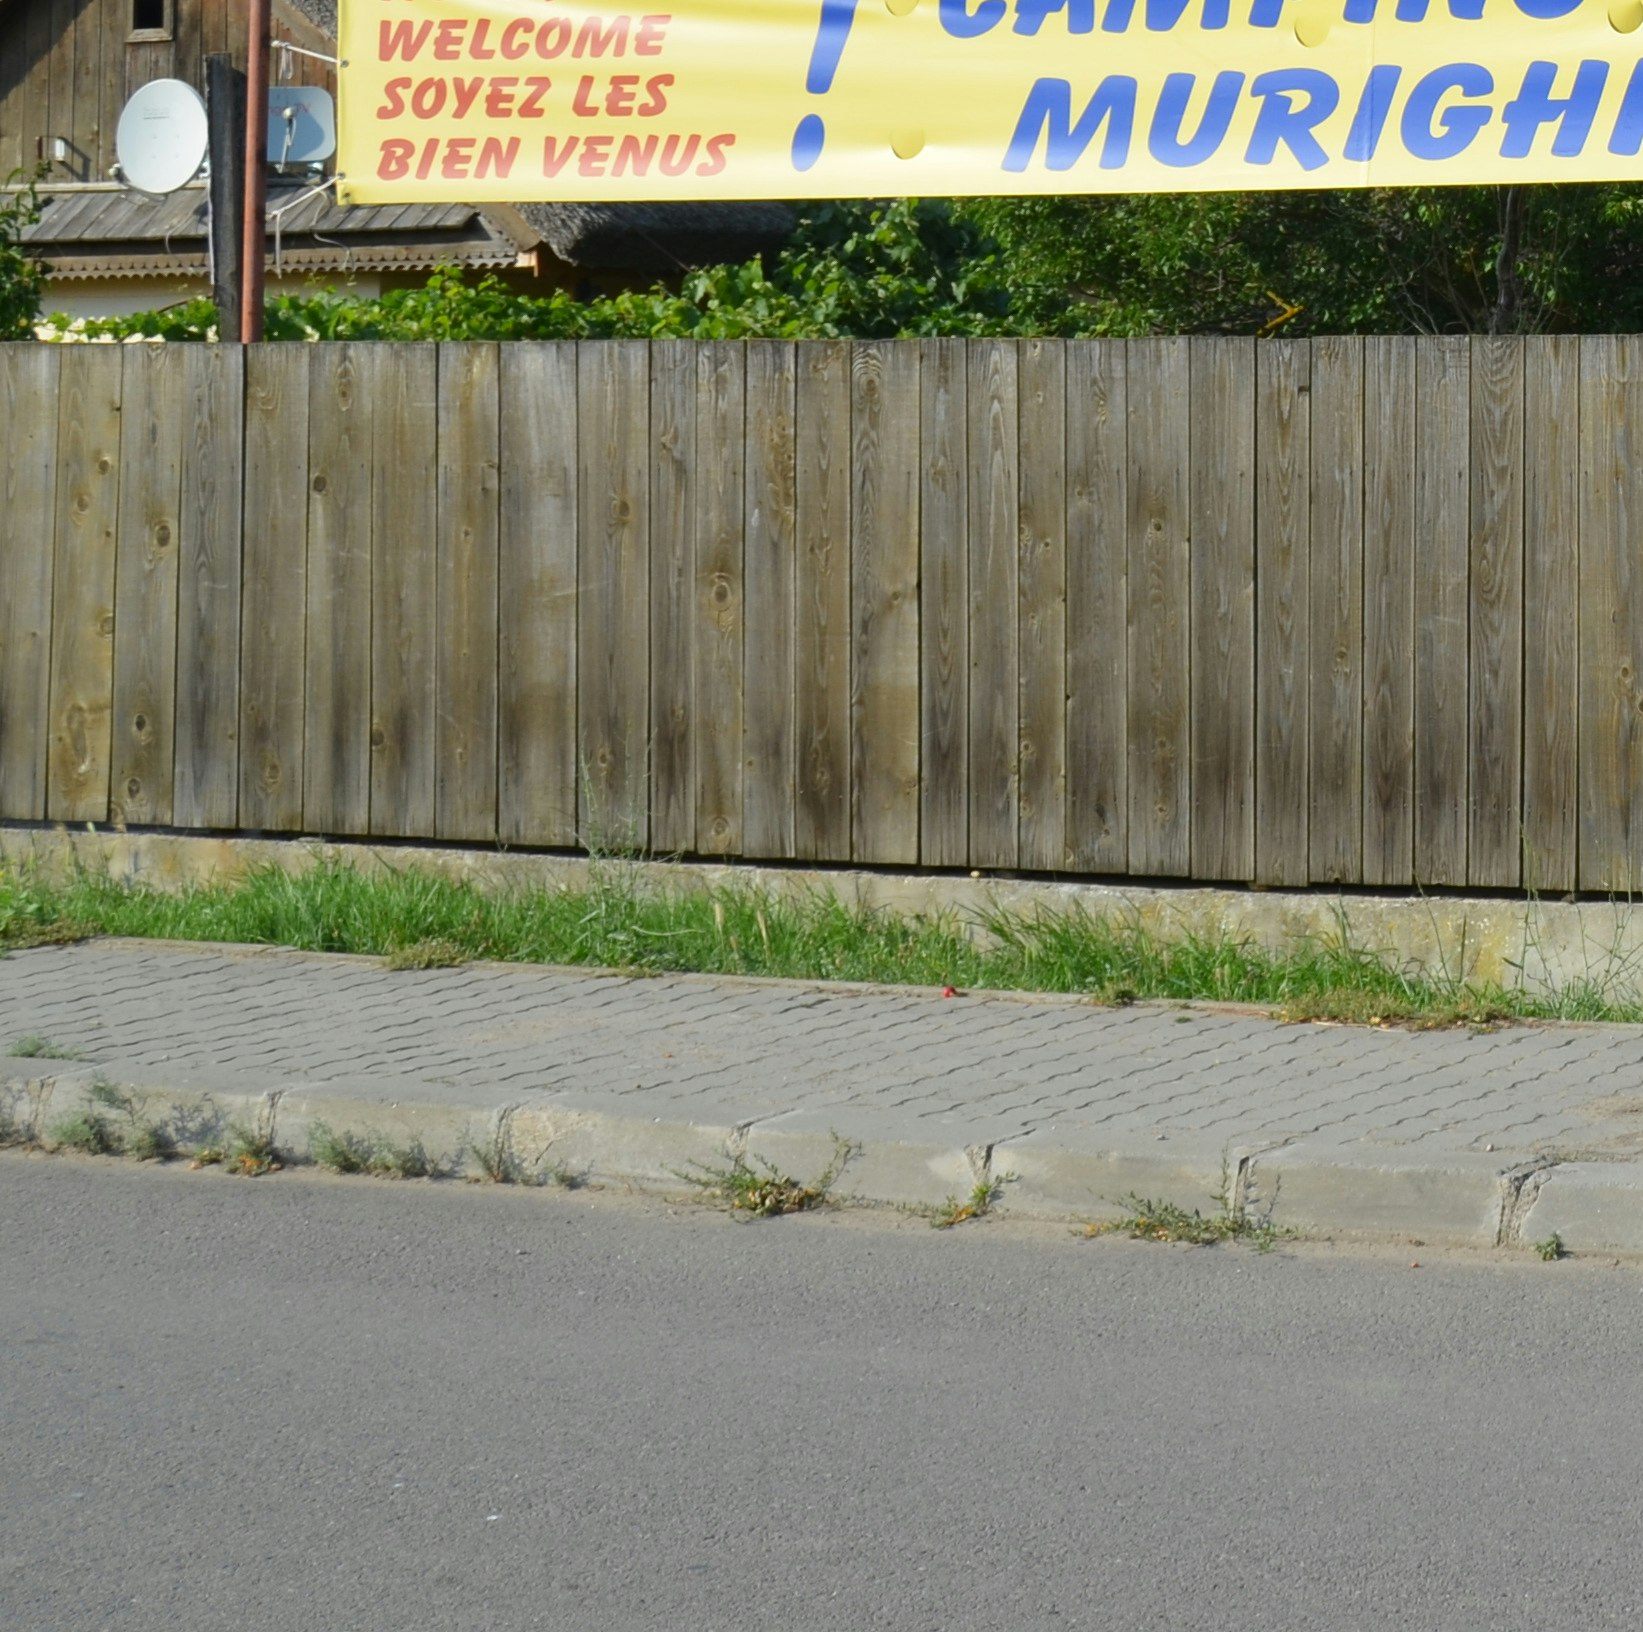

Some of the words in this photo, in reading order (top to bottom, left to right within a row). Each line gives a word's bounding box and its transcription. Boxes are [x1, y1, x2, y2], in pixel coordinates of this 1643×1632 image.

[377, 13, 671, 62] WELCOME
[376, 76, 552, 120] SOYEZ
[571, 73, 675, 117] LES
[376, 137, 521, 181] BIEN
[541, 133, 736, 177] VENUS
